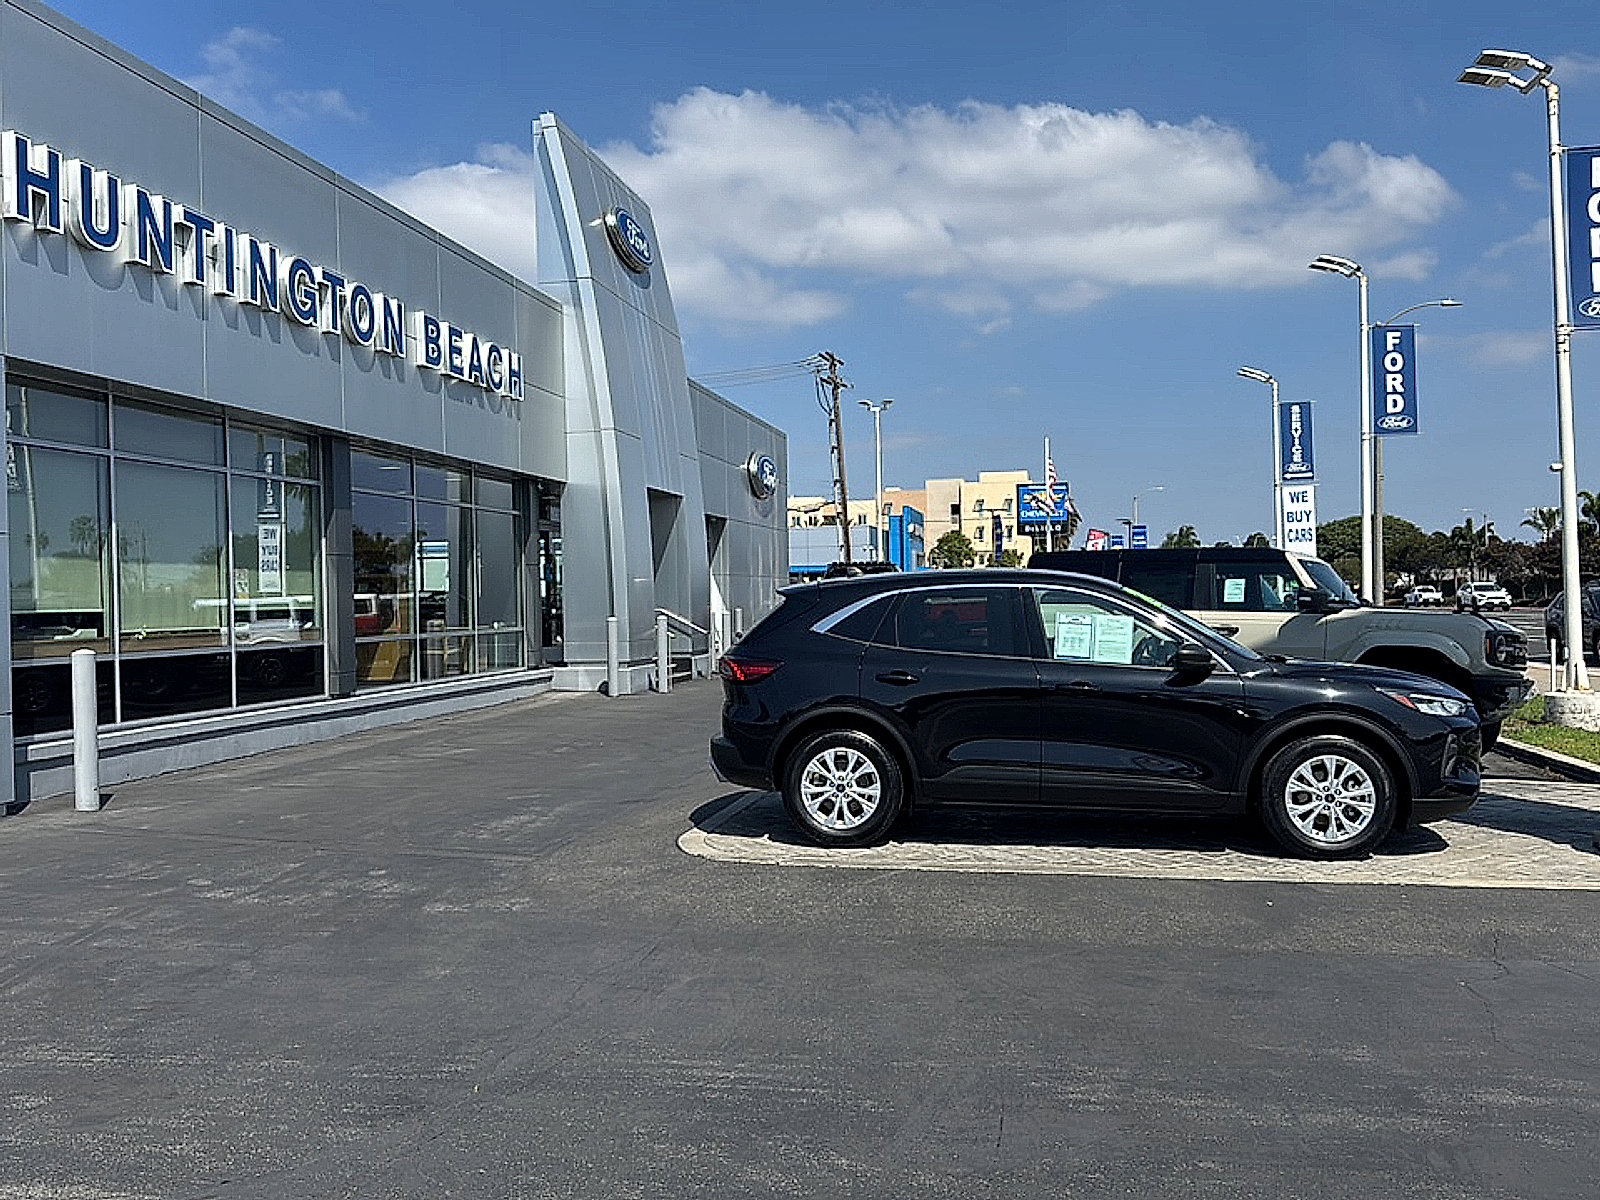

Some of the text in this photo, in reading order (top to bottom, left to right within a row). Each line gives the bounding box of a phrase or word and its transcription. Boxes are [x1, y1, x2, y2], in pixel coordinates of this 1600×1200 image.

[8, 131, 524, 401] HUNTINGTON BEACH
[1383, 331, 1405, 414] FORD
[1289, 491, 1308, 503] WE
[1287, 510, 1312, 522] BUY
[1287, 527, 1313, 543] CARS
